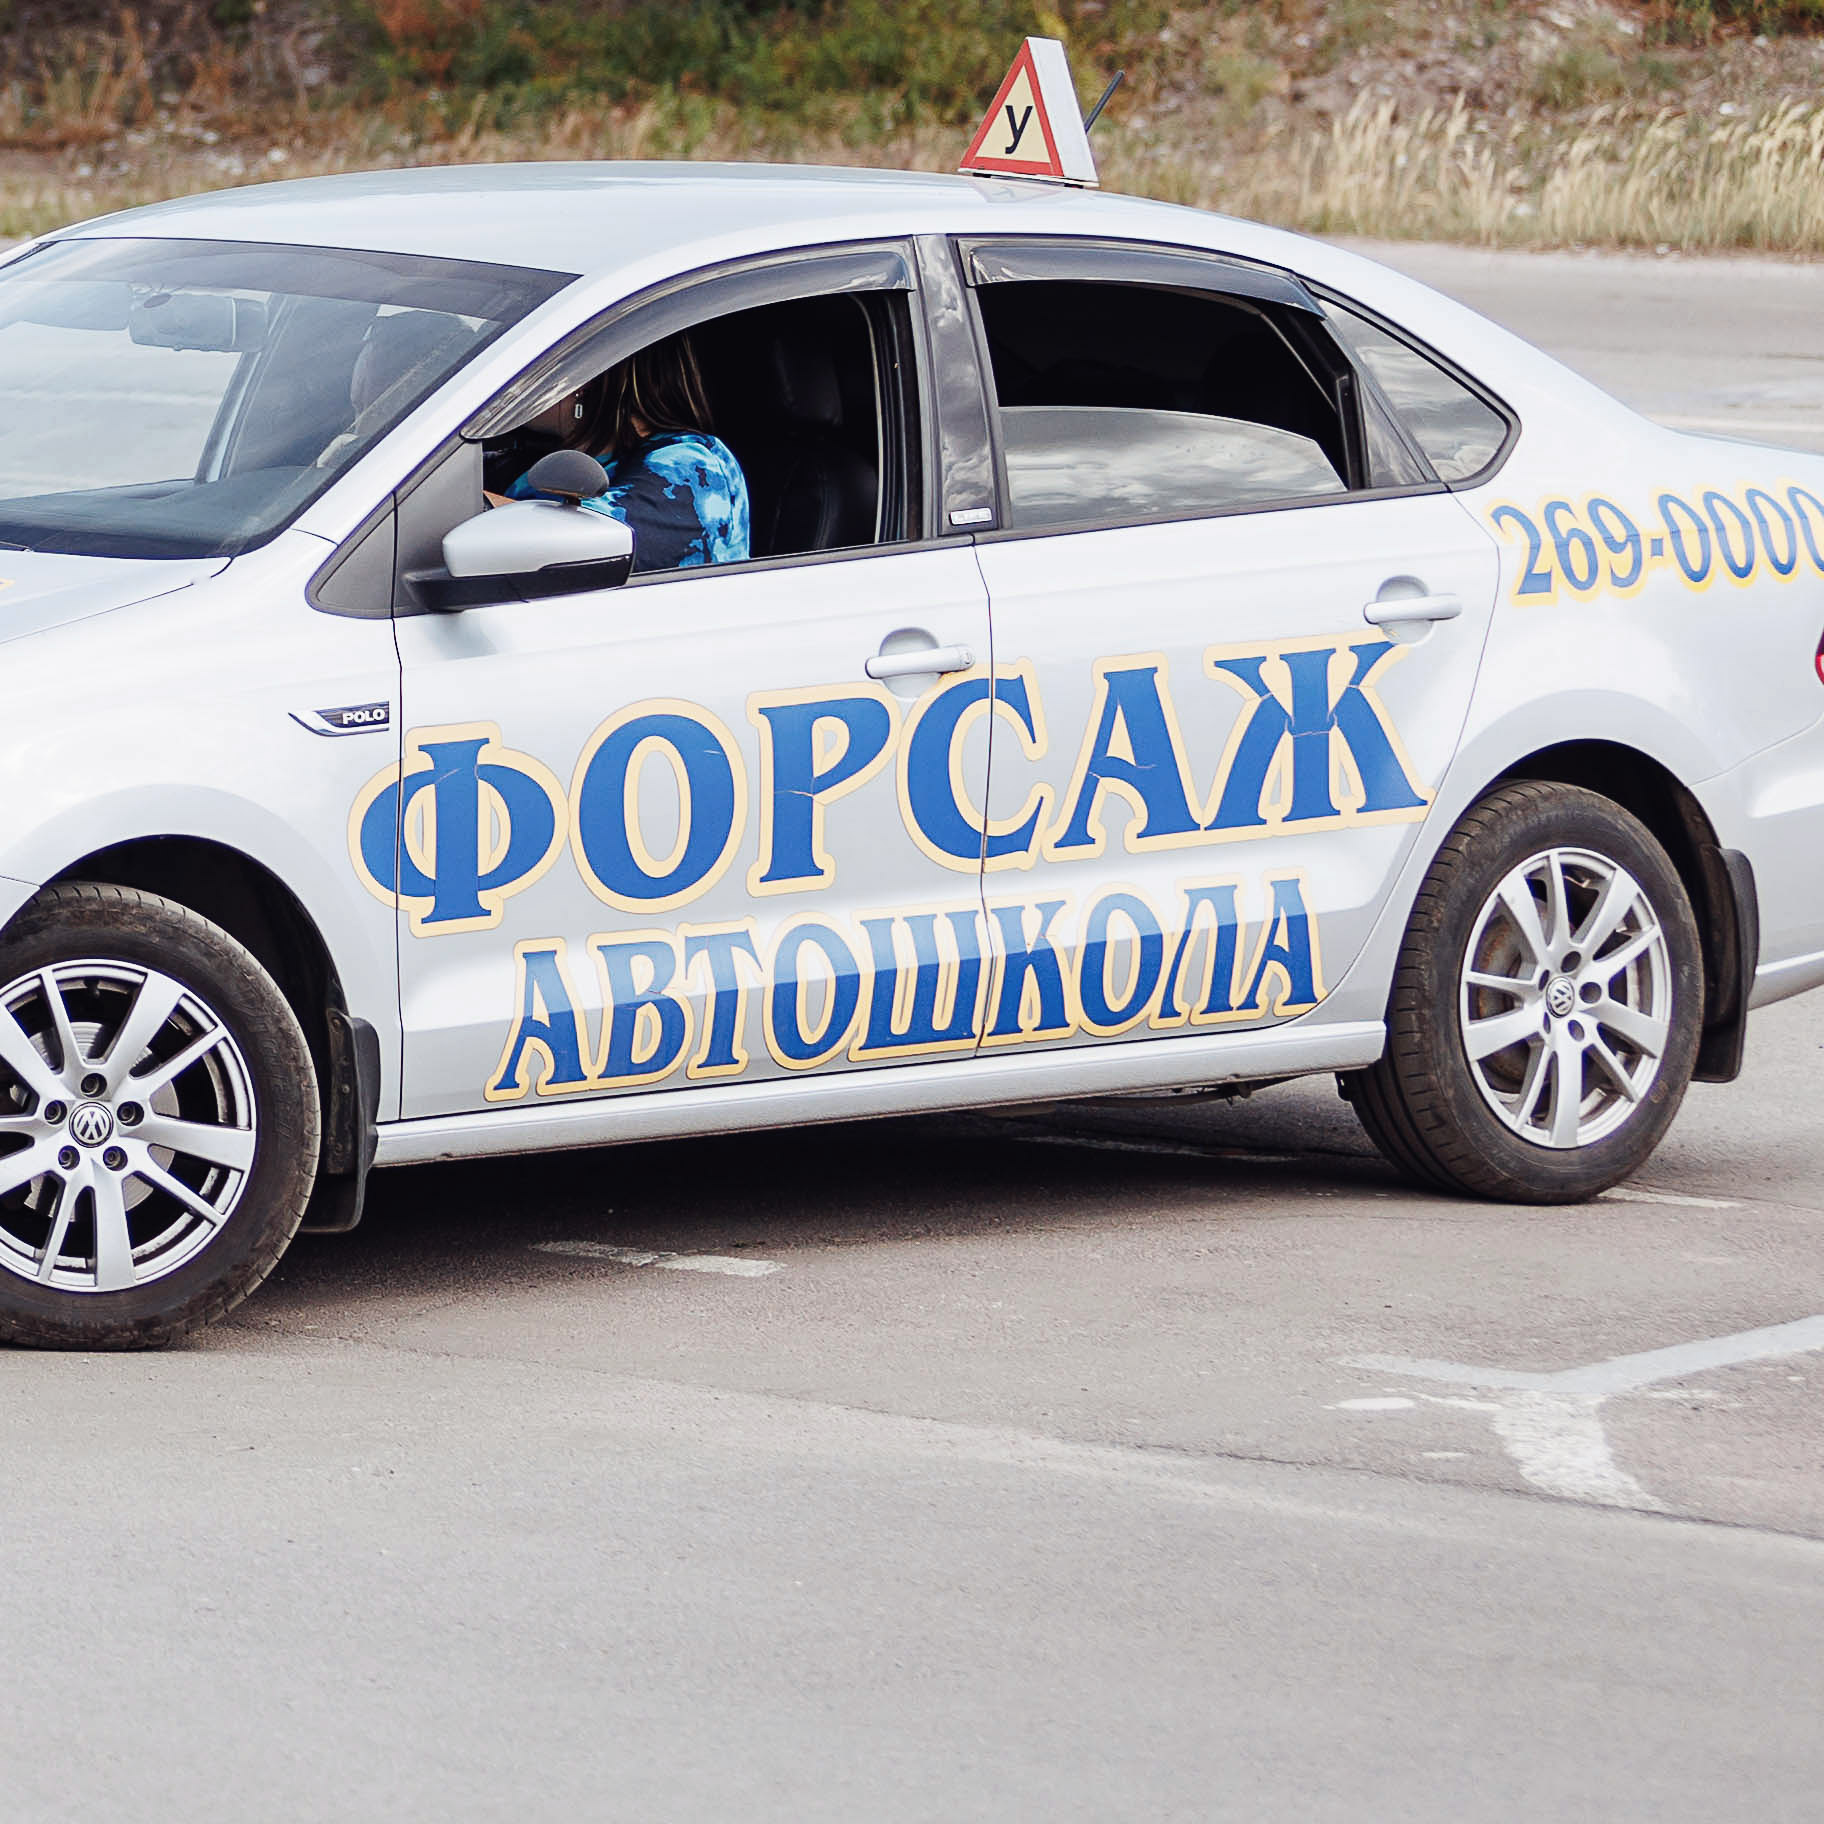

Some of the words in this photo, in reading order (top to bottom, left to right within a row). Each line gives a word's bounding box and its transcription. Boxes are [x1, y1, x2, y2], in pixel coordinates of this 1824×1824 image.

[342, 708, 386, 725] POLO
[357, 640, 1429, 927] ФОРСАЖ
[493, 876, 1321, 1091] АВТОШКОЛА
